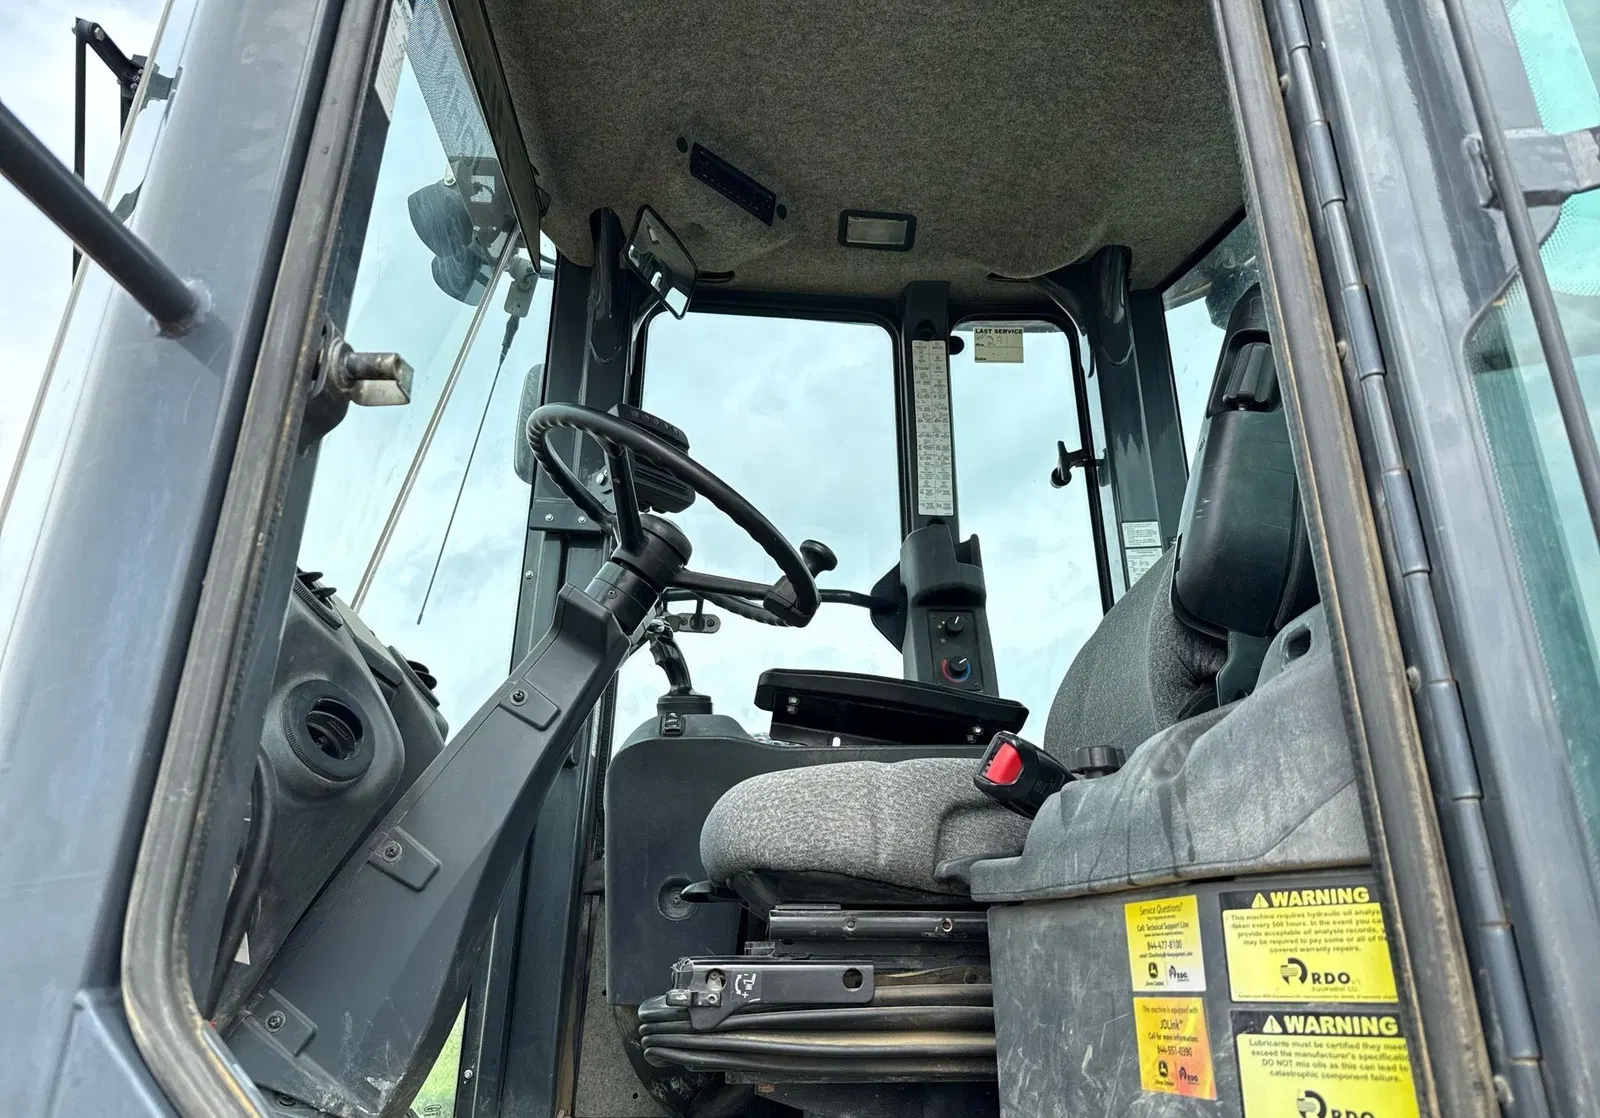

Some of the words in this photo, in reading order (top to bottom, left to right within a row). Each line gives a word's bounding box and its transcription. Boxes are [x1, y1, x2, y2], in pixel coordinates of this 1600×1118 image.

[1270, 886, 1370, 907] WARNING
[1139, 905, 1156, 916] Service
[1156, 901, 1183, 914] Questions?
[1276, 911, 1306, 921] requires
[1307, 909, 1341, 919] hydraulic
[1146, 922, 1164, 931] Technical
[1251, 921, 1270, 929] every
[1237, 930, 1262, 938] provide
[1264, 928, 1302, 937] acceptable
[1314, 927, 1344, 937] analysis
[1147, 939, 1182, 951] 844-477-8100
[1269, 937, 1299, 946] required
[1309, 937, 1322, 945] pay
[1299, 945, 1331, 954] warranty
[1333, 944, 1362, 953] repairs.
[1311, 971, 1351, 985] RDO
[1151, 1005, 1167, 1013] machine
[1283, 1015, 1399, 1036] WARNING
[1249, 1038, 1290, 1047] Lubricants
[1291, 1040, 1312, 1048] must
[1326, 1041, 1361, 1050] certified
[1362, 1042, 1381, 1051] they
[1251, 1049, 1279, 1057] exceed
[1280, 1049, 1292, 1057] the
[1294, 1050, 1356, 1060] manufacturer's
[1262, 1058, 1274, 1067] DO
[1276, 1059, 1293, 1067] NOT
[1312, 1060, 1327, 1069] oils
[1341, 1062, 1357, 1070] this
[1377, 1063, 1398, 1072] lead
[1269, 1069, 1319, 1079] catastrophic
[1320, 1072, 1368, 1082] component
[1370, 1073, 1403, 1083] failure.
